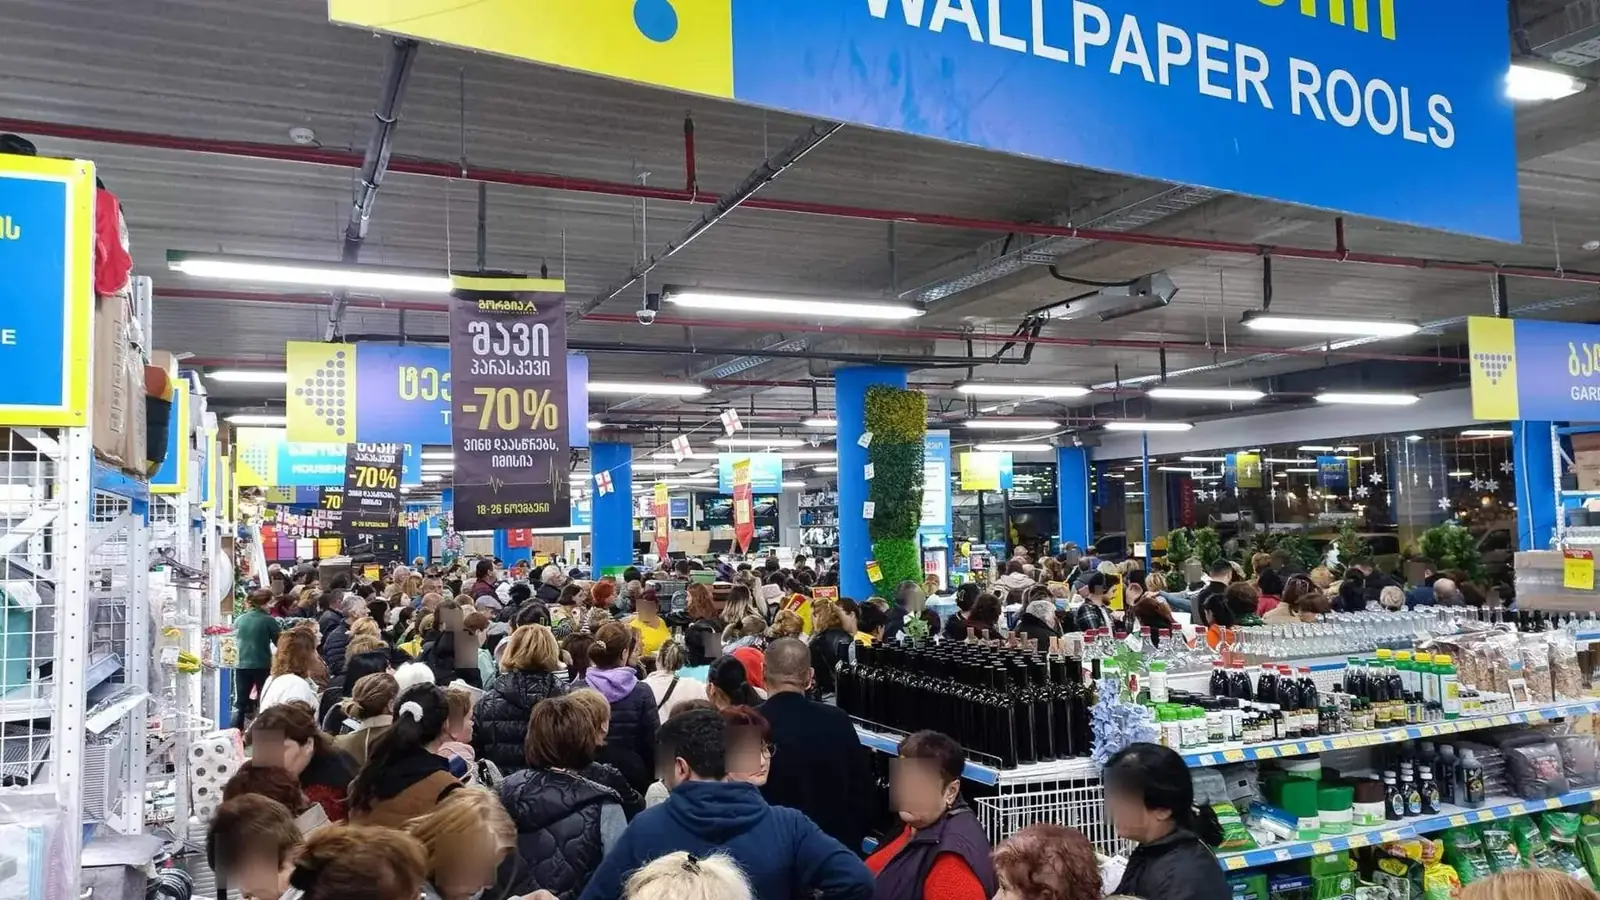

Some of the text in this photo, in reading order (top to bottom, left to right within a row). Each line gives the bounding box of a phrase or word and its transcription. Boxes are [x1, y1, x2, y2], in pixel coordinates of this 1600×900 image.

[1289, 57, 1455, 149] ROOLS
[468, 321, 550, 357] შავი
[471, 359, 551, 376] პარასკევი
[462, 387, 559, 430] -70%
[463, 438, 559, 452] ვინც დაასწრებს,
[491, 455, 533, 468] იმისია
[349, 466, 397, 489] -70%
[321, 495, 344, 509] -70
[476, 503, 550, 515] 18-26 ნოემბერი
